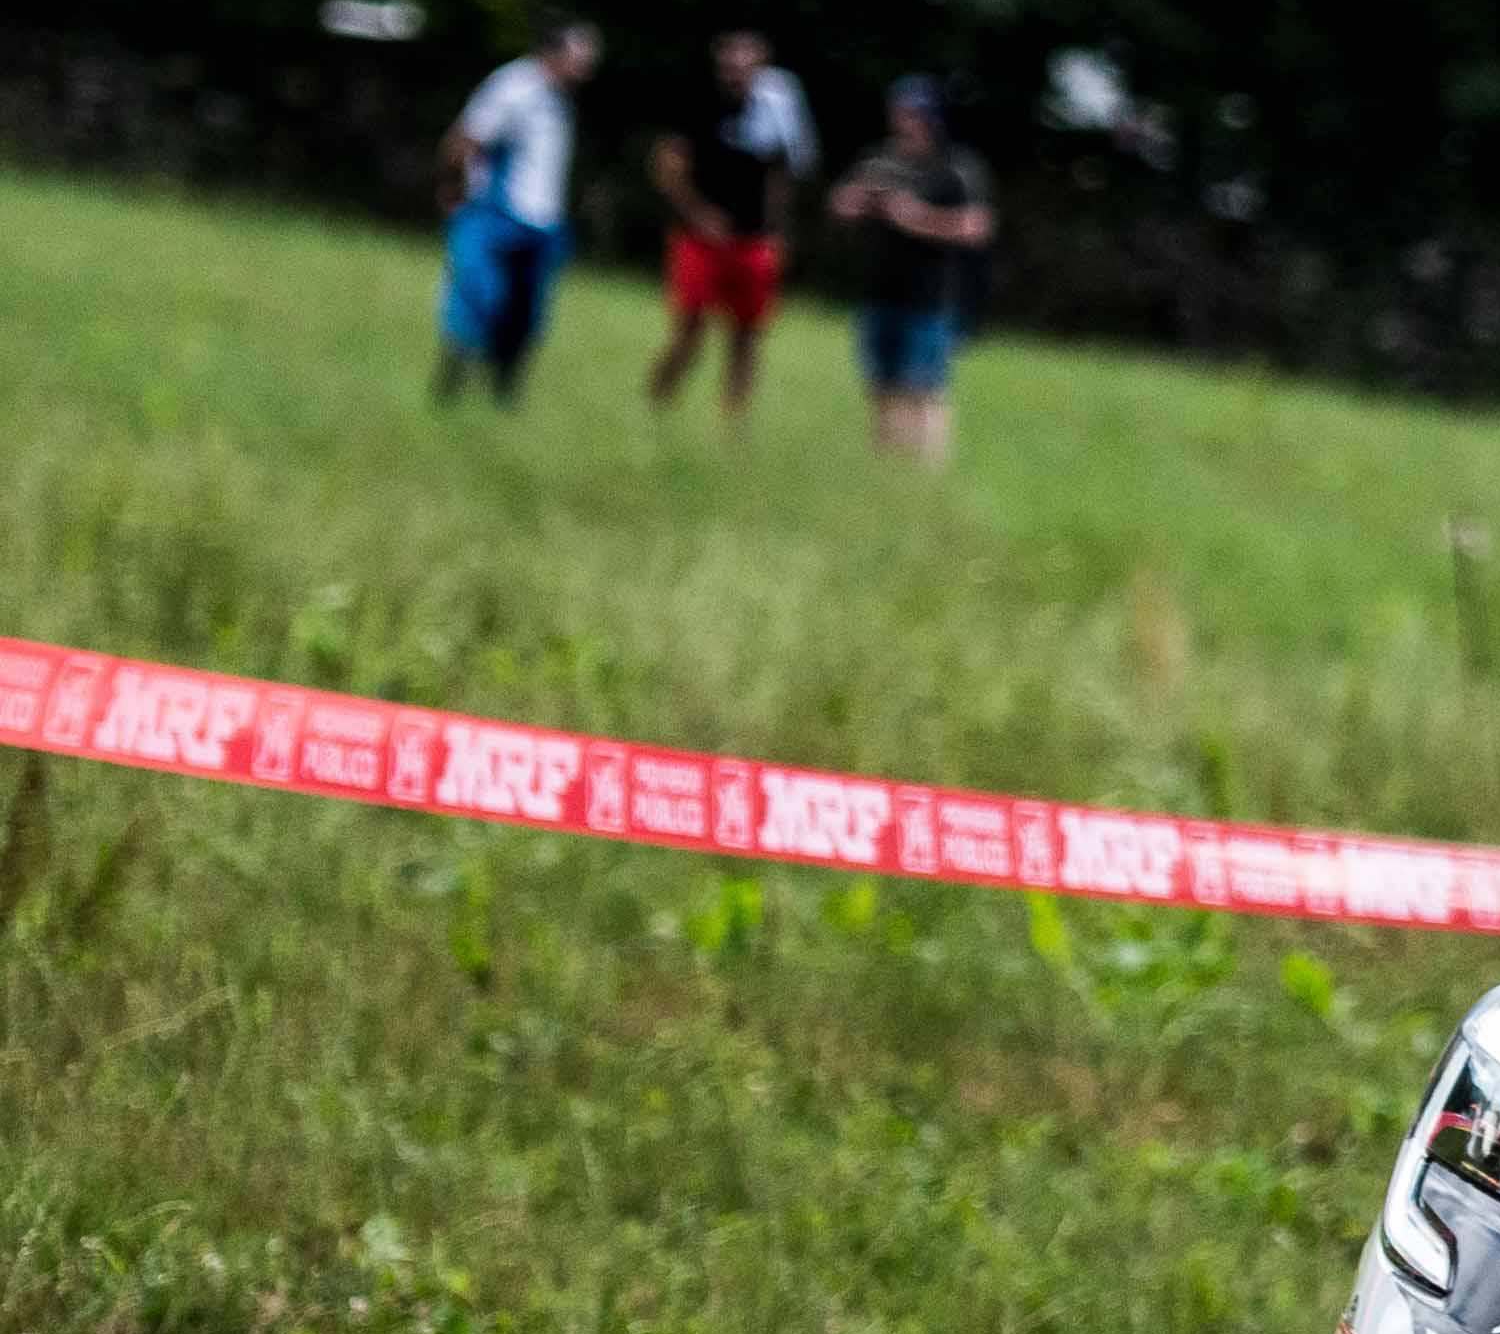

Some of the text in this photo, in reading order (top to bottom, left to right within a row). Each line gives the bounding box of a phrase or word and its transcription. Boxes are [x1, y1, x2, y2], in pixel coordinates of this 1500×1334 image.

[94, 664, 258, 771] MRF
[435, 722, 580, 822] MRF
[758, 768, 890, 864] MRF
[1057, 809, 1181, 900] MRF
